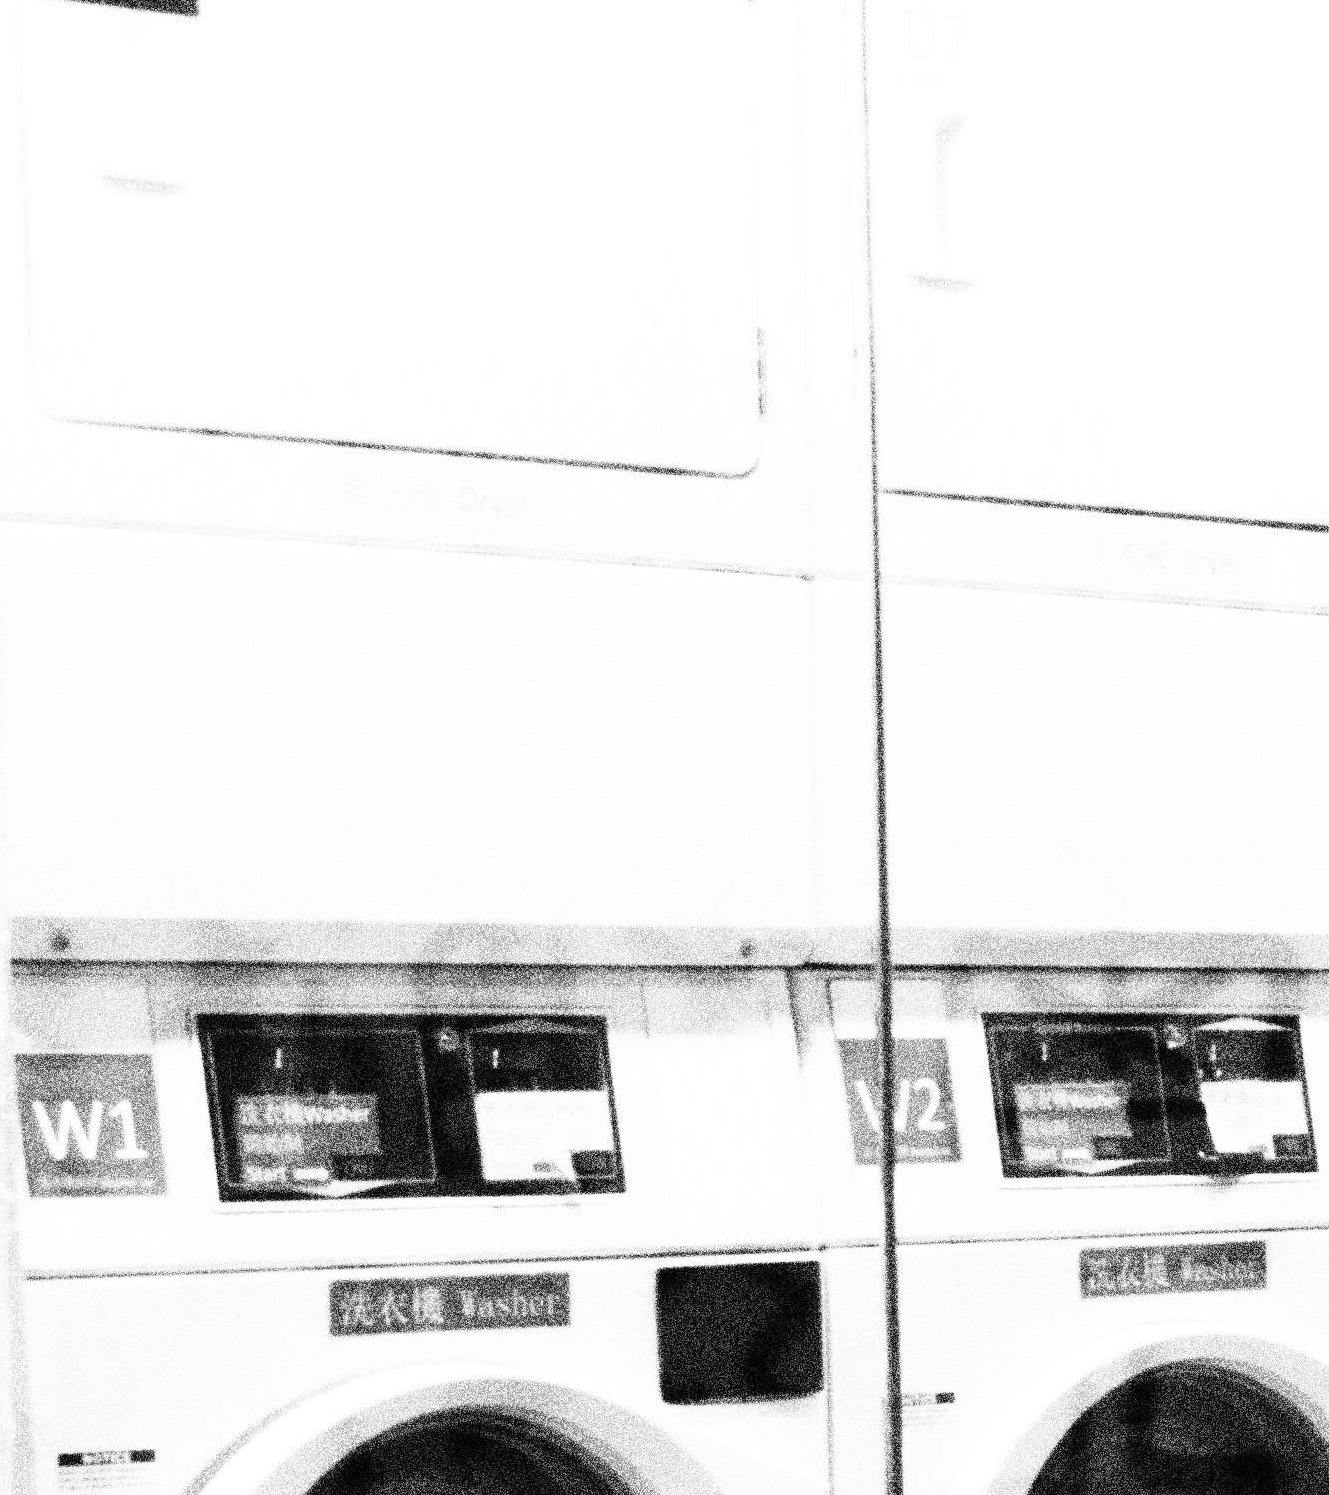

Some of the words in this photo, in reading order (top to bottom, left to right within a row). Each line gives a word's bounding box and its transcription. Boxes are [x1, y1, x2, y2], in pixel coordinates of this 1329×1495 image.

[31, 1099, 149, 1161] W1
[853, 1077, 946, 1132] W2
[340, 1285, 444, 1327] 洗衣機
[458, 1286, 560, 1319] Washer
